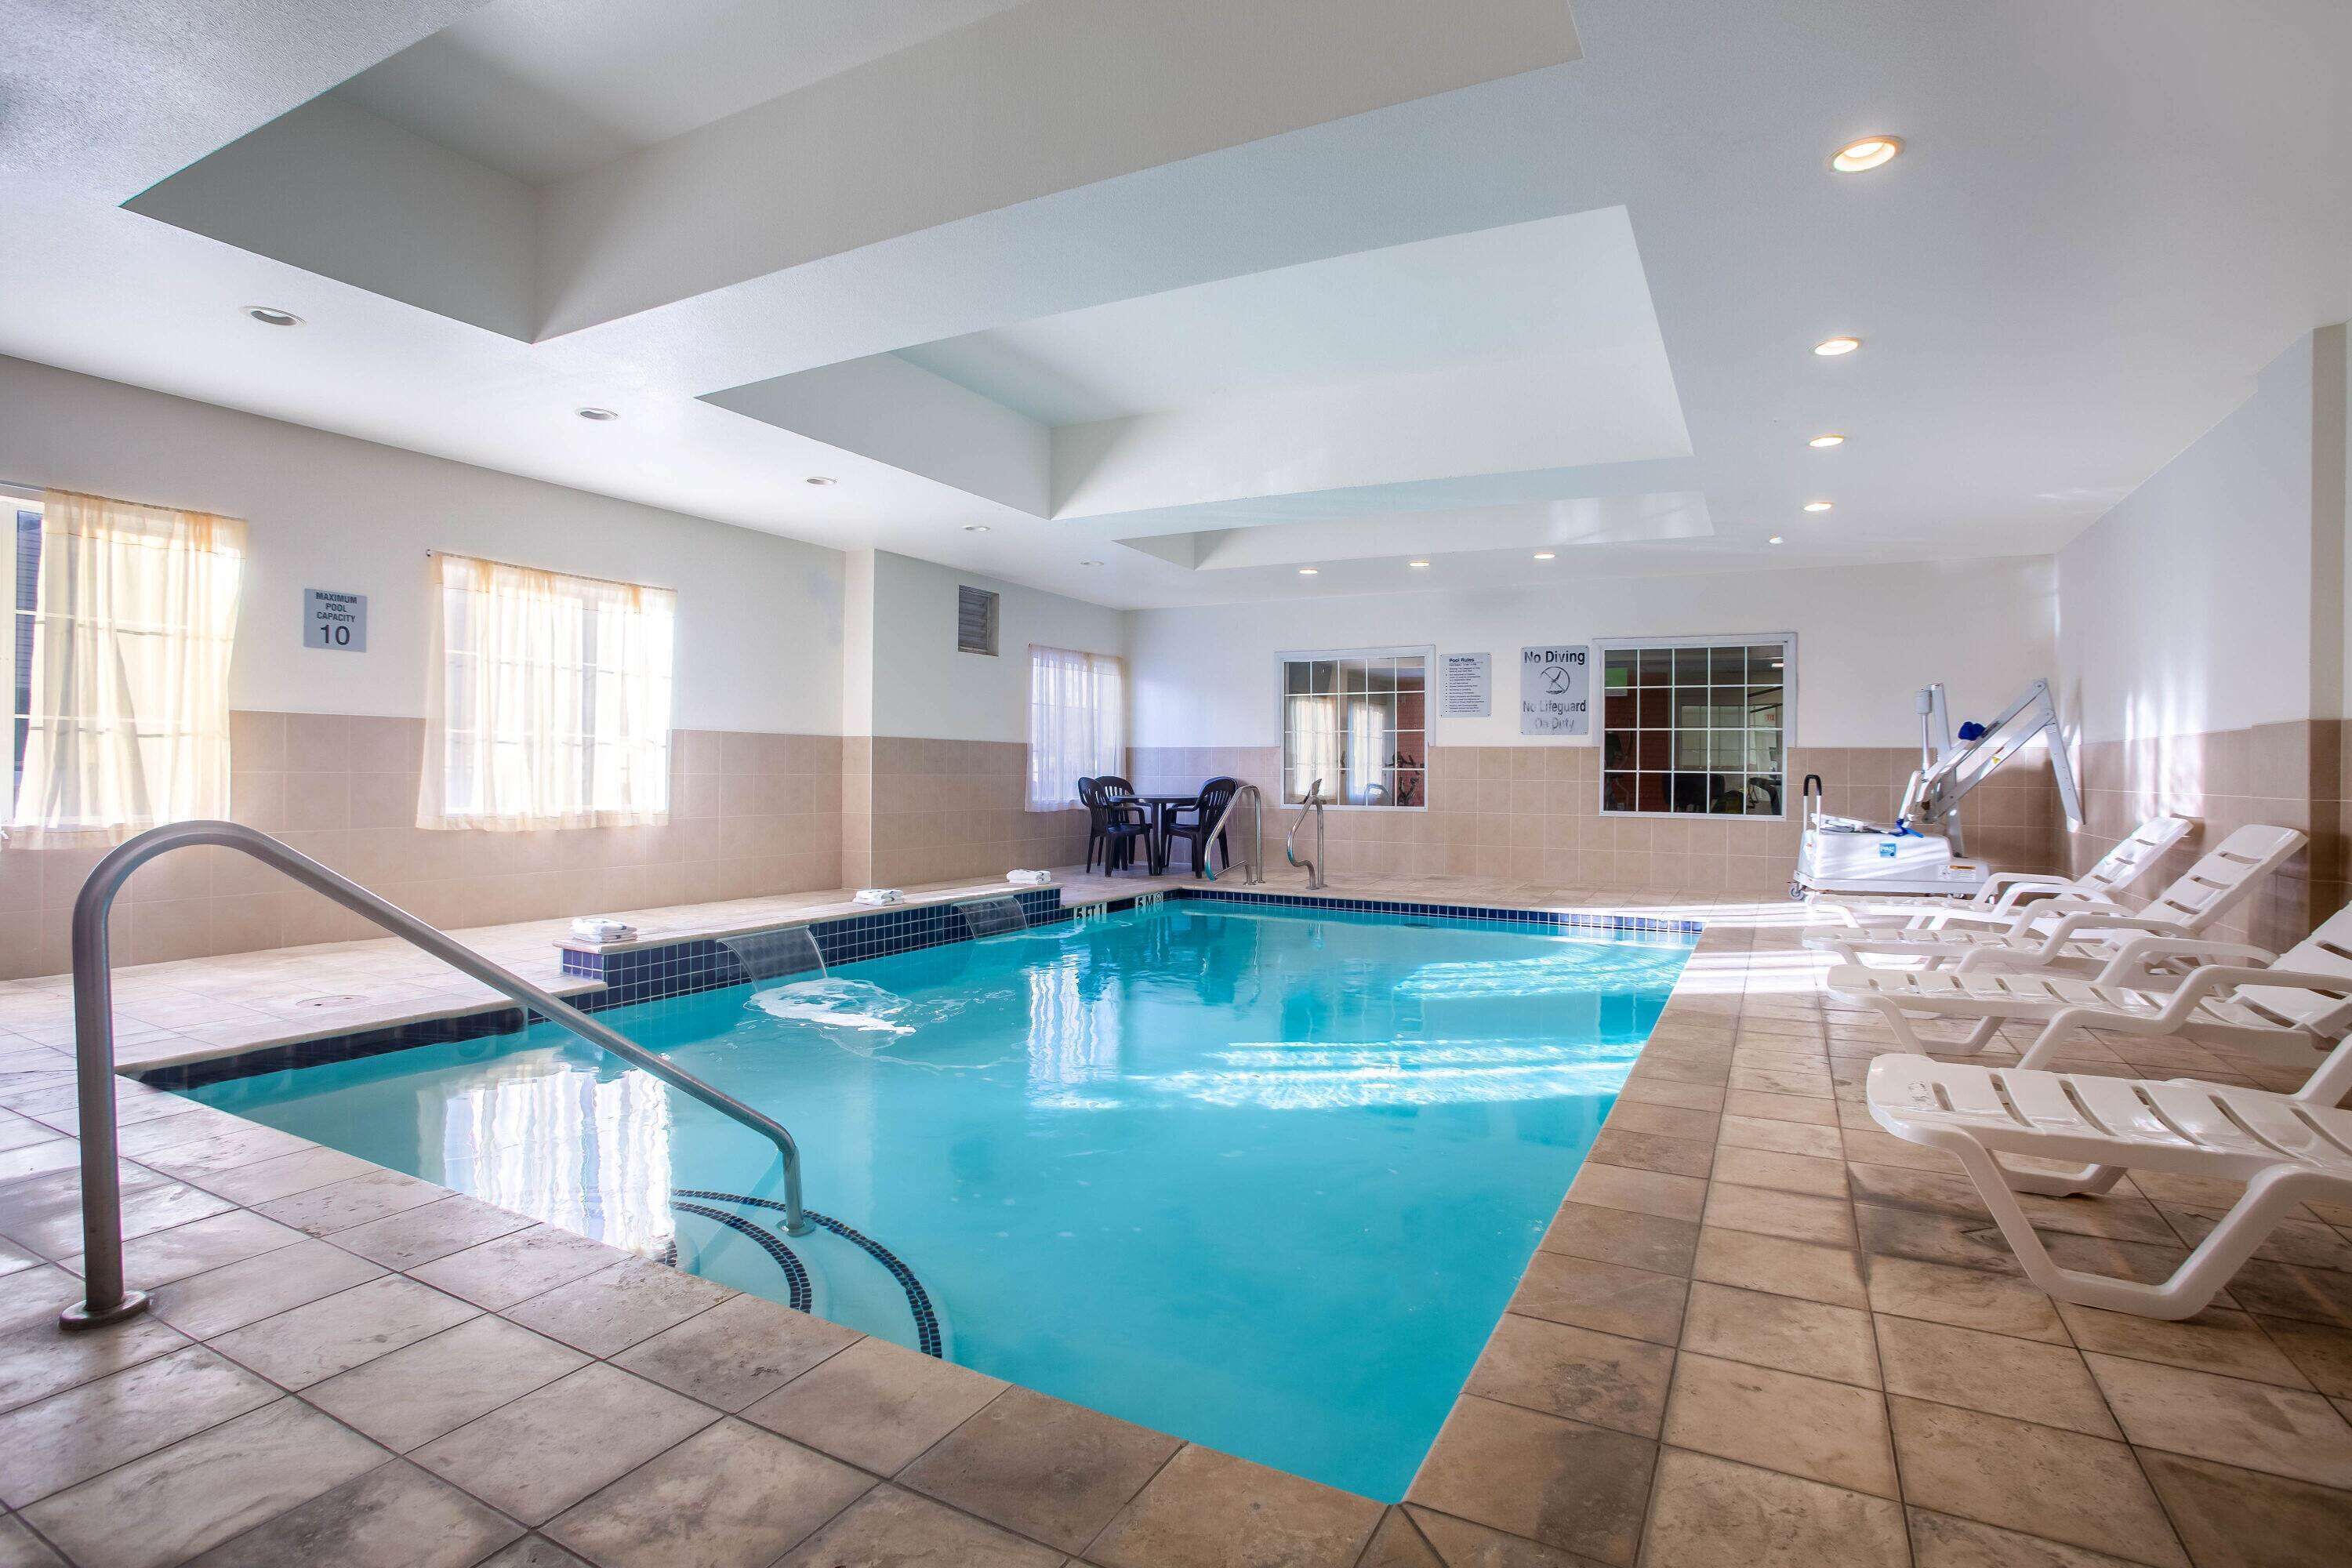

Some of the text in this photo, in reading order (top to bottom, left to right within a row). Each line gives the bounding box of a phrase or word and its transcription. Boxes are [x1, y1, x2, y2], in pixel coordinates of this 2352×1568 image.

[315, 592, 358, 604] MAXIMUM
[325, 602, 347, 612] POOL
[316, 612, 356, 622] CAPACITY
[320, 624, 350, 646] 10
[1524, 650, 1585, 666] No Diving
[1539, 699, 1586, 715] Lifeguard
[1076, 907, 1083, 918] 5
[1085, 905, 1096, 918] FT
[1138, 896, 1144, 909] 5
[1145, 894, 1154, 907] M
